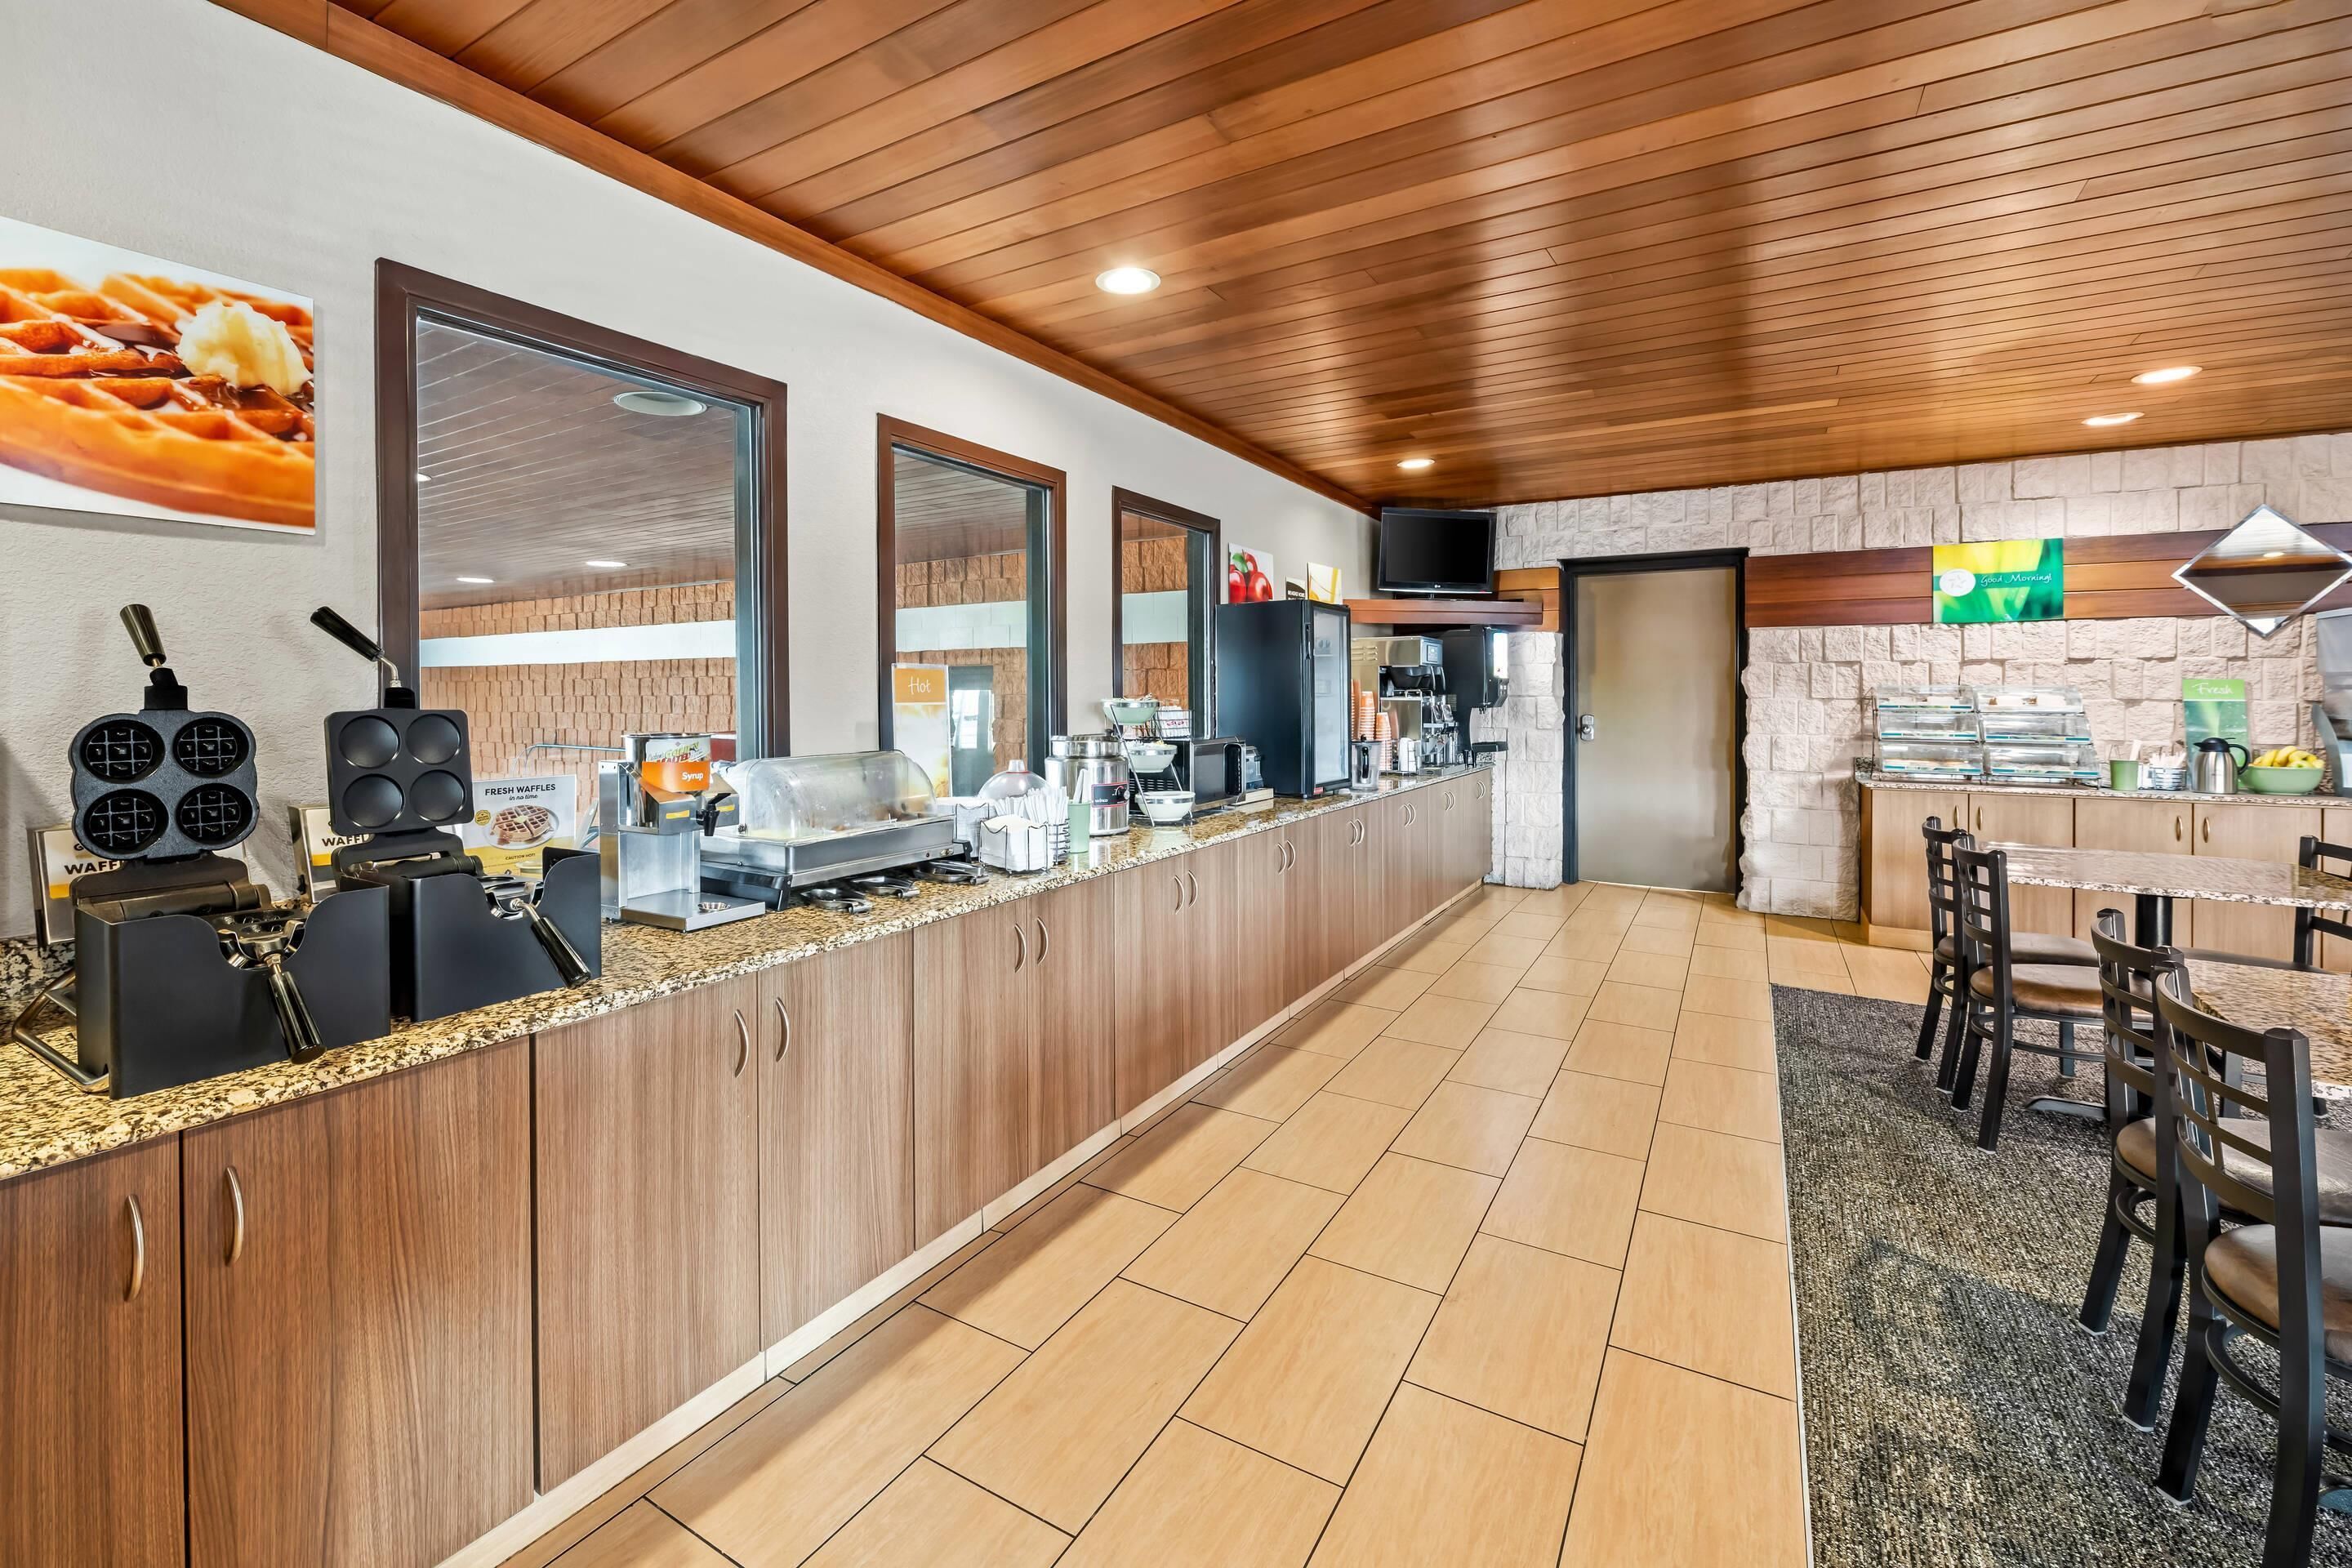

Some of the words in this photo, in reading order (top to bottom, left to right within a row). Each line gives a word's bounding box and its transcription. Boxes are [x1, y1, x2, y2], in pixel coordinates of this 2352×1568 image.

[1980, 574, 2002, 586] Good
[2006, 572, 2052, 584] Morning!
[908, 675, 931, 695] Hot
[2191, 682, 2234, 695] Fresh
[682, 772, 704, 782] Syrup
[485, 786, 514, 796] FRESH
[516, 783, 556, 793] WAFFLES
[321, 833, 366, 847] WAFFL
[64, 860, 118, 875] WAFF
